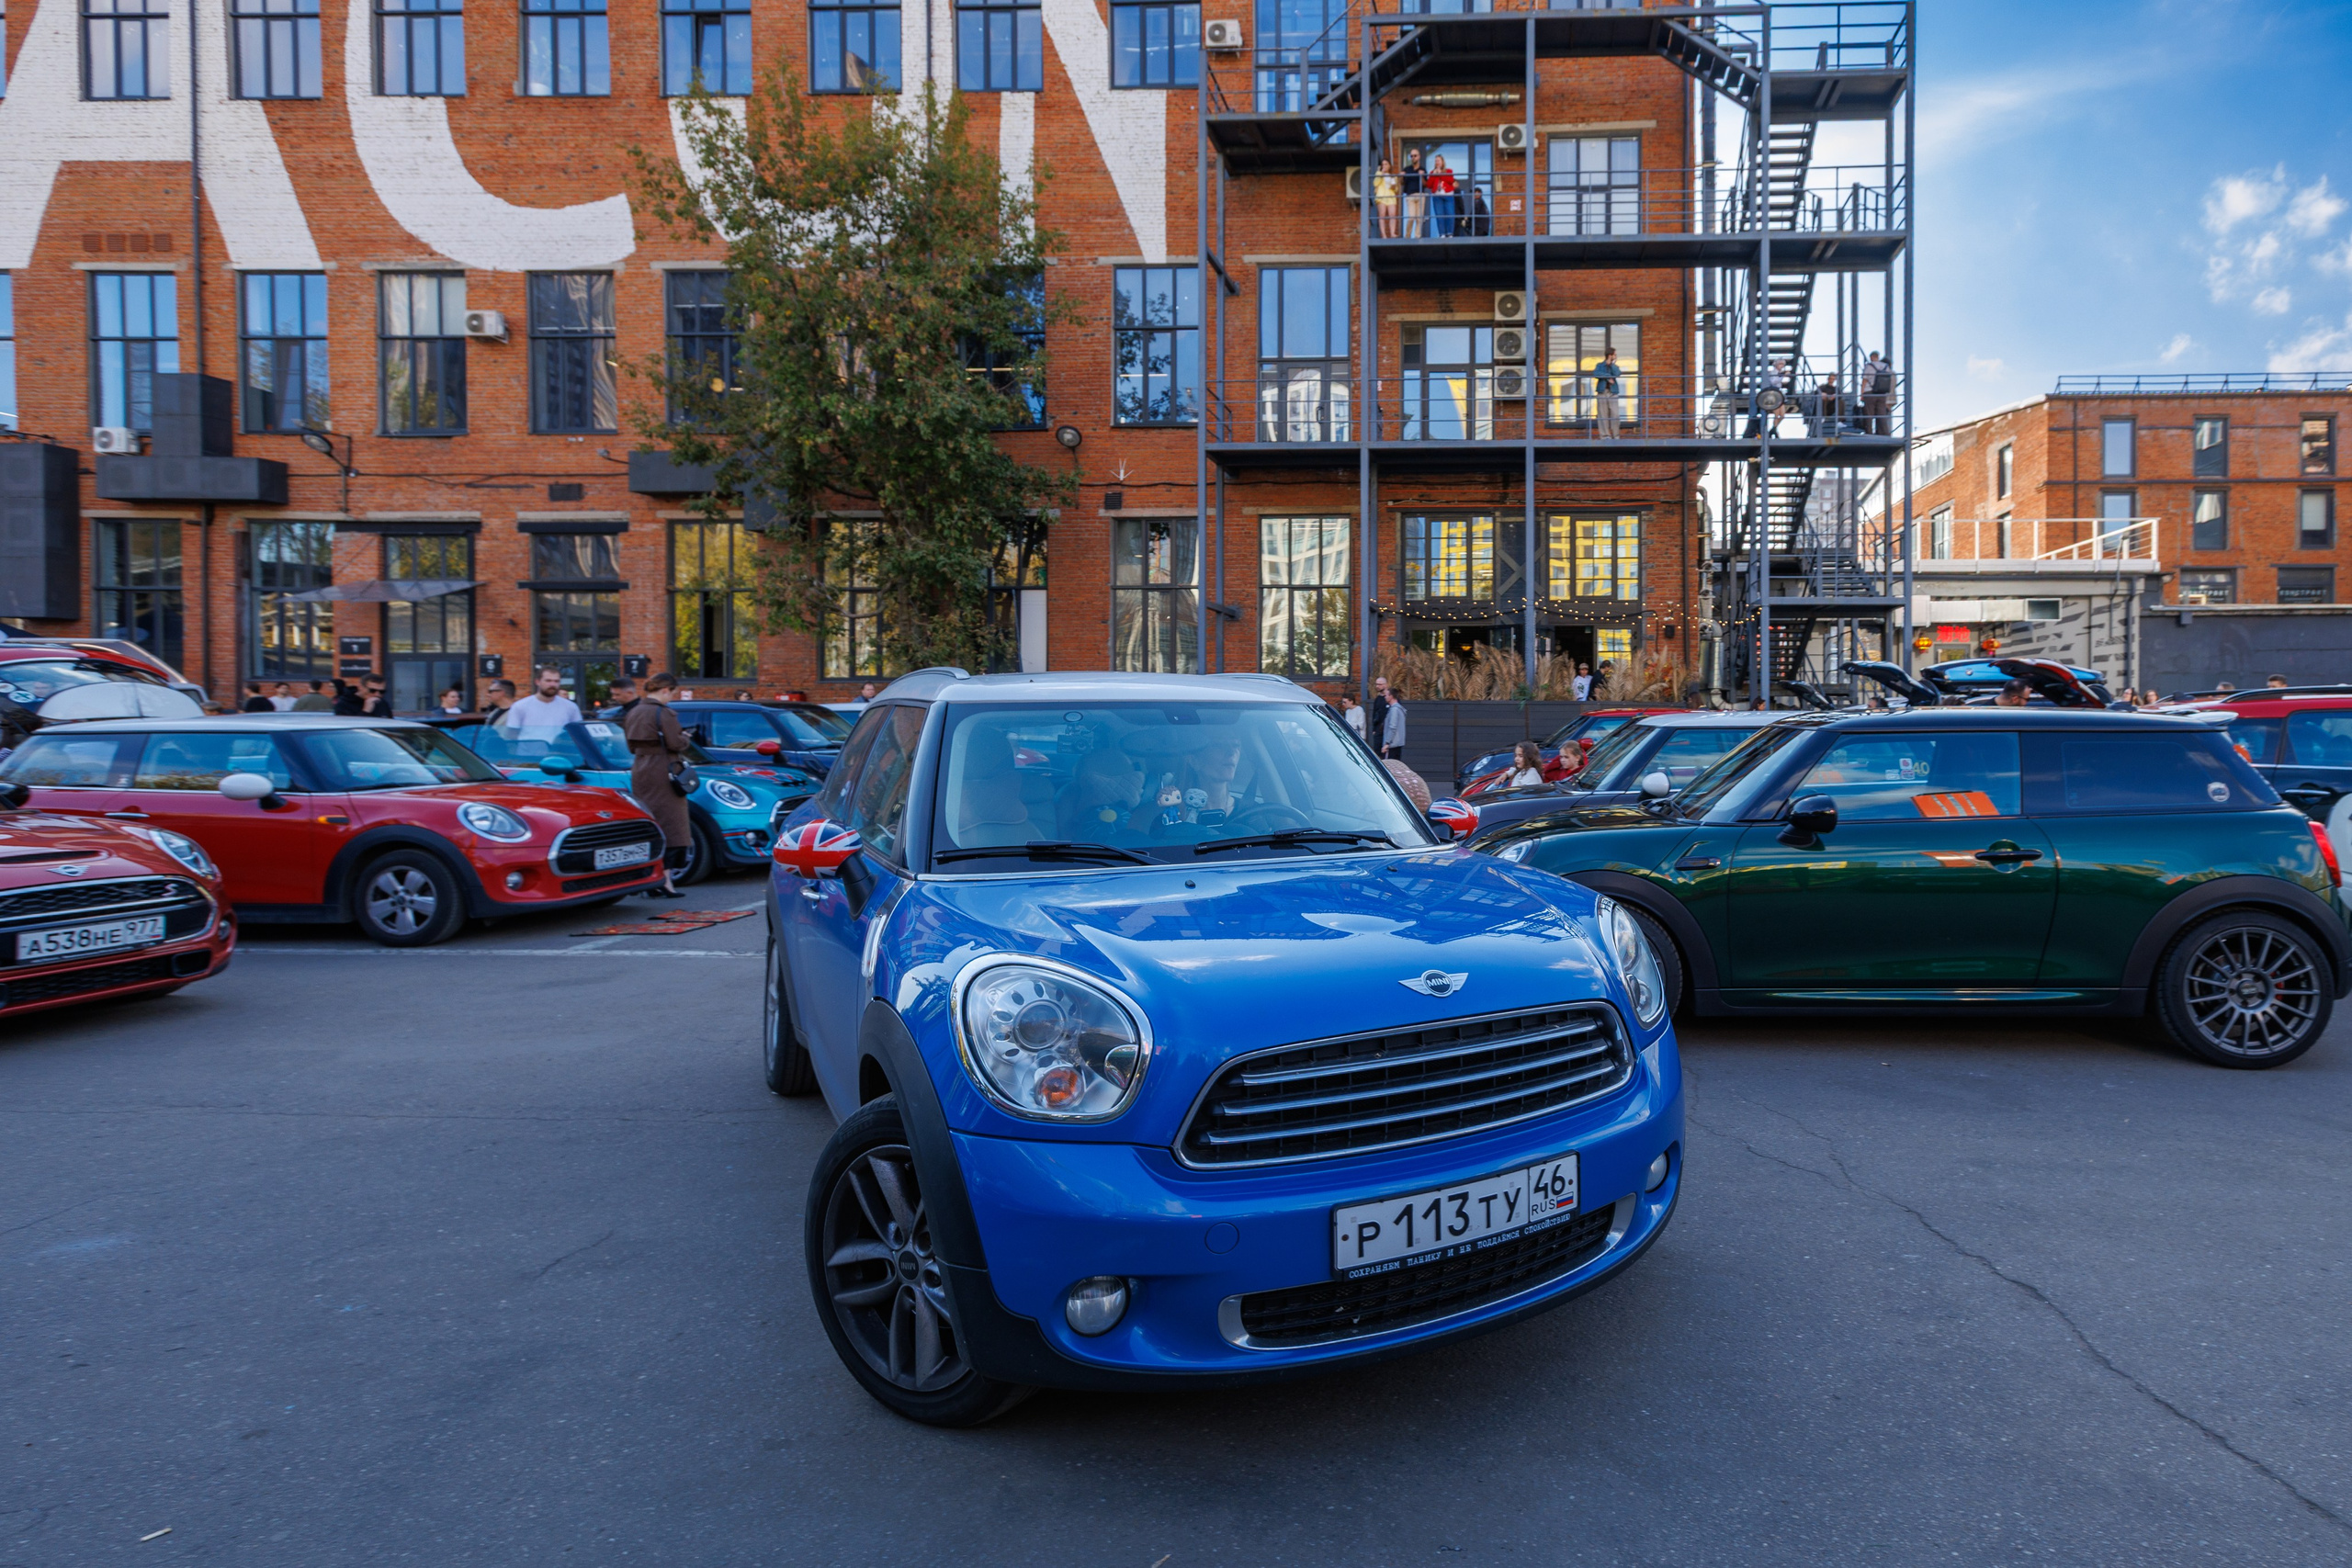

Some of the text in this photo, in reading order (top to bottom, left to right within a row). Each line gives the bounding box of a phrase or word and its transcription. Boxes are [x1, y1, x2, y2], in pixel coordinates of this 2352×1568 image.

[630, 660, 639, 670] 7
[27, 928, 121, 956] А538НЕ
[126, 919, 159, 936] 977
[1426, 977, 1450, 987] MINI
[1532, 1163, 1566, 1200] 46
[1531, 1198, 1556, 1216] RUS
[1349, 1260, 1401, 1279] СОХРАНЯЕМ
[1406, 1251, 1442, 1267] ПАНИКУ
[1447, 1248, 1454, 1258] И
[1459, 1245, 1472, 1254] НЕ
[1523, 1213, 1571, 1235] СПОКОЙСТВИЮ
